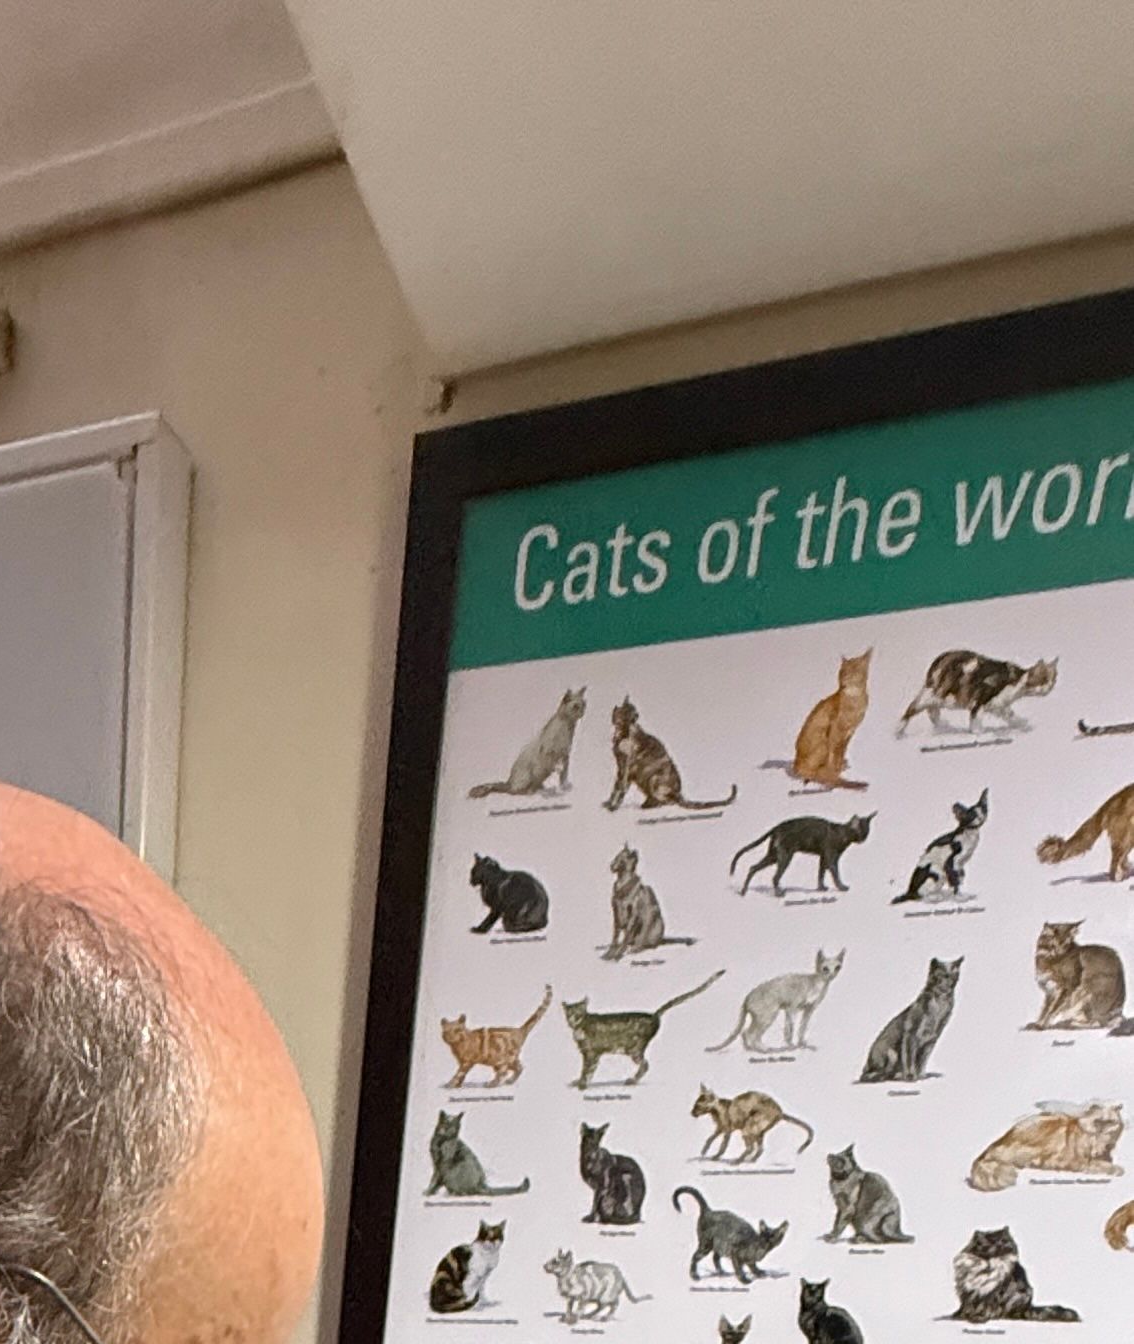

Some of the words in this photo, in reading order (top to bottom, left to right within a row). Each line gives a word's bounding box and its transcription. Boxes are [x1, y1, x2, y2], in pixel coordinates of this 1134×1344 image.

[515, 523, 671, 611] Cats
[697, 487, 780, 583] of
[796, 475, 922, 569] the
